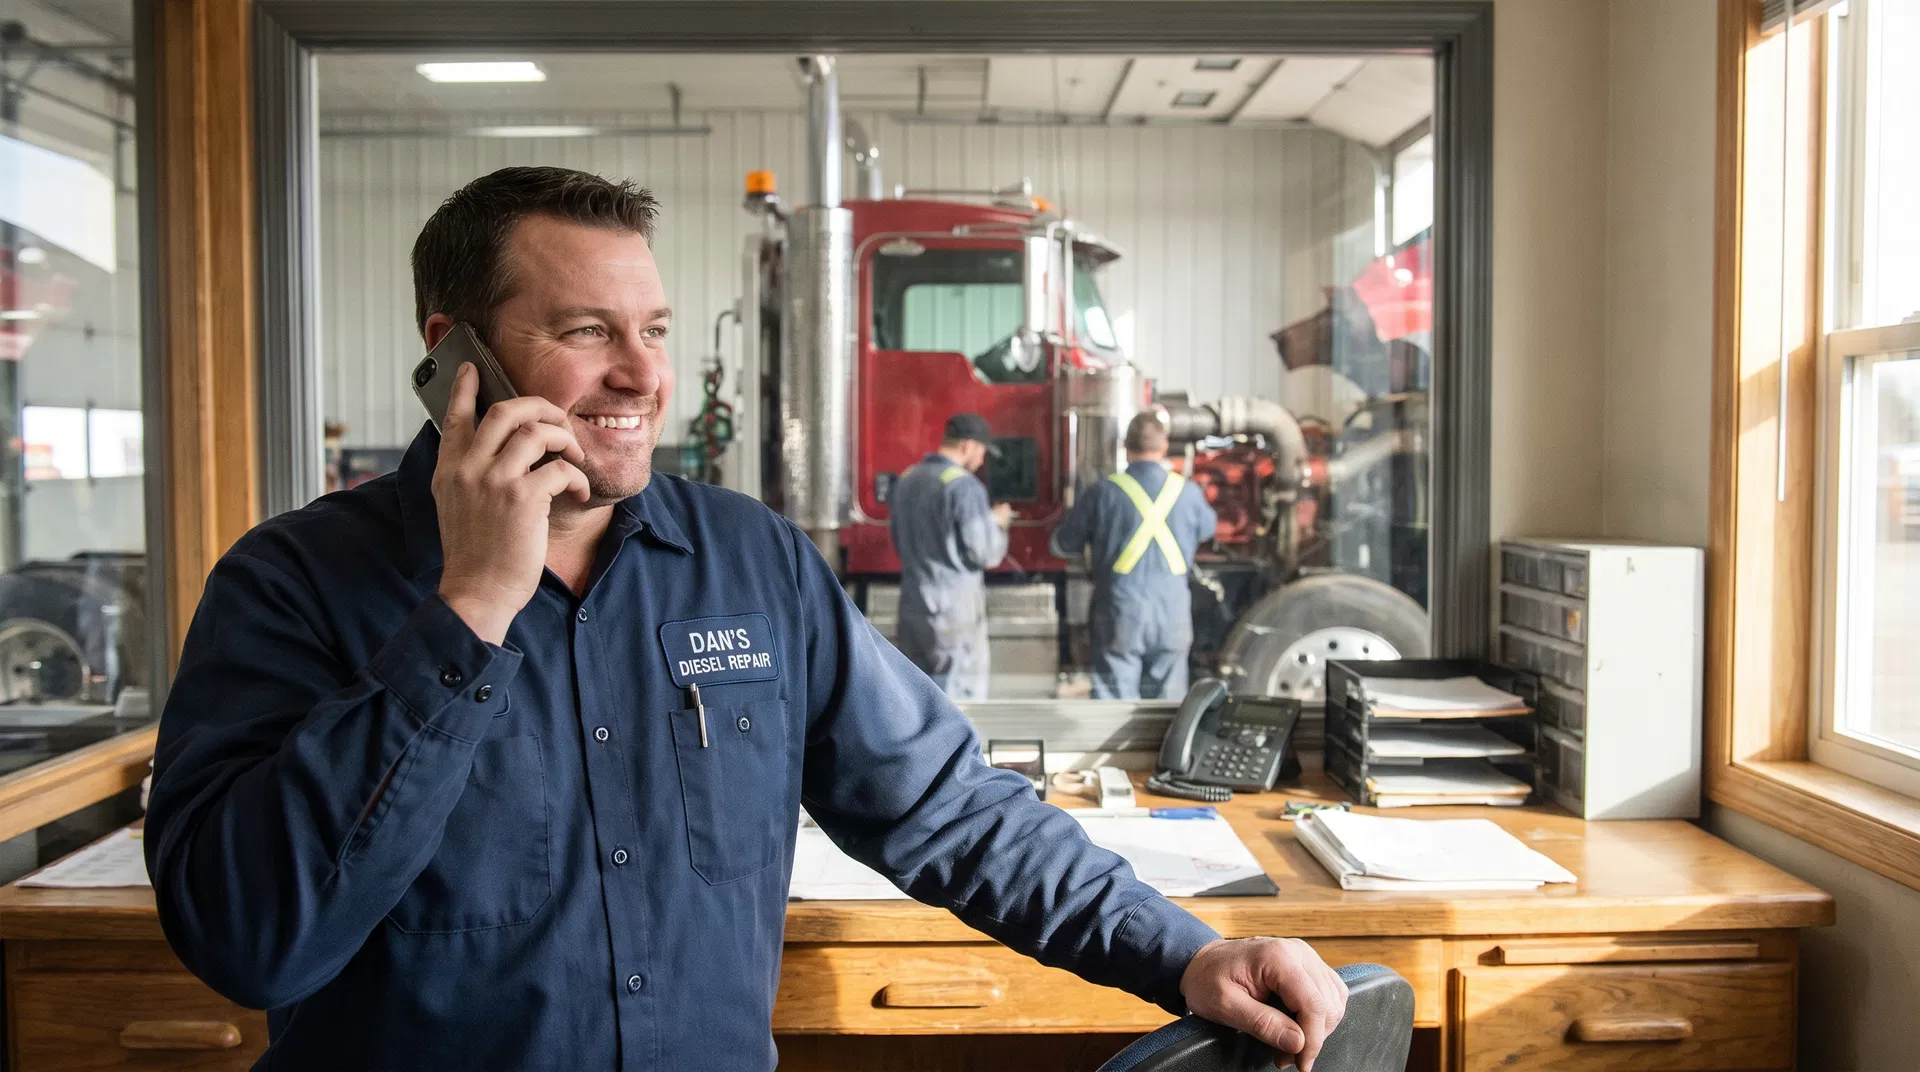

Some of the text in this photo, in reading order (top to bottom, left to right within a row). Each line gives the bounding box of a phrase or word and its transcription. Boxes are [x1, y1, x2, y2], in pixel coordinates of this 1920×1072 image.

[689, 628, 751, 654] DAN'S
[679, 652, 772, 676] DIESEL REPAIR
